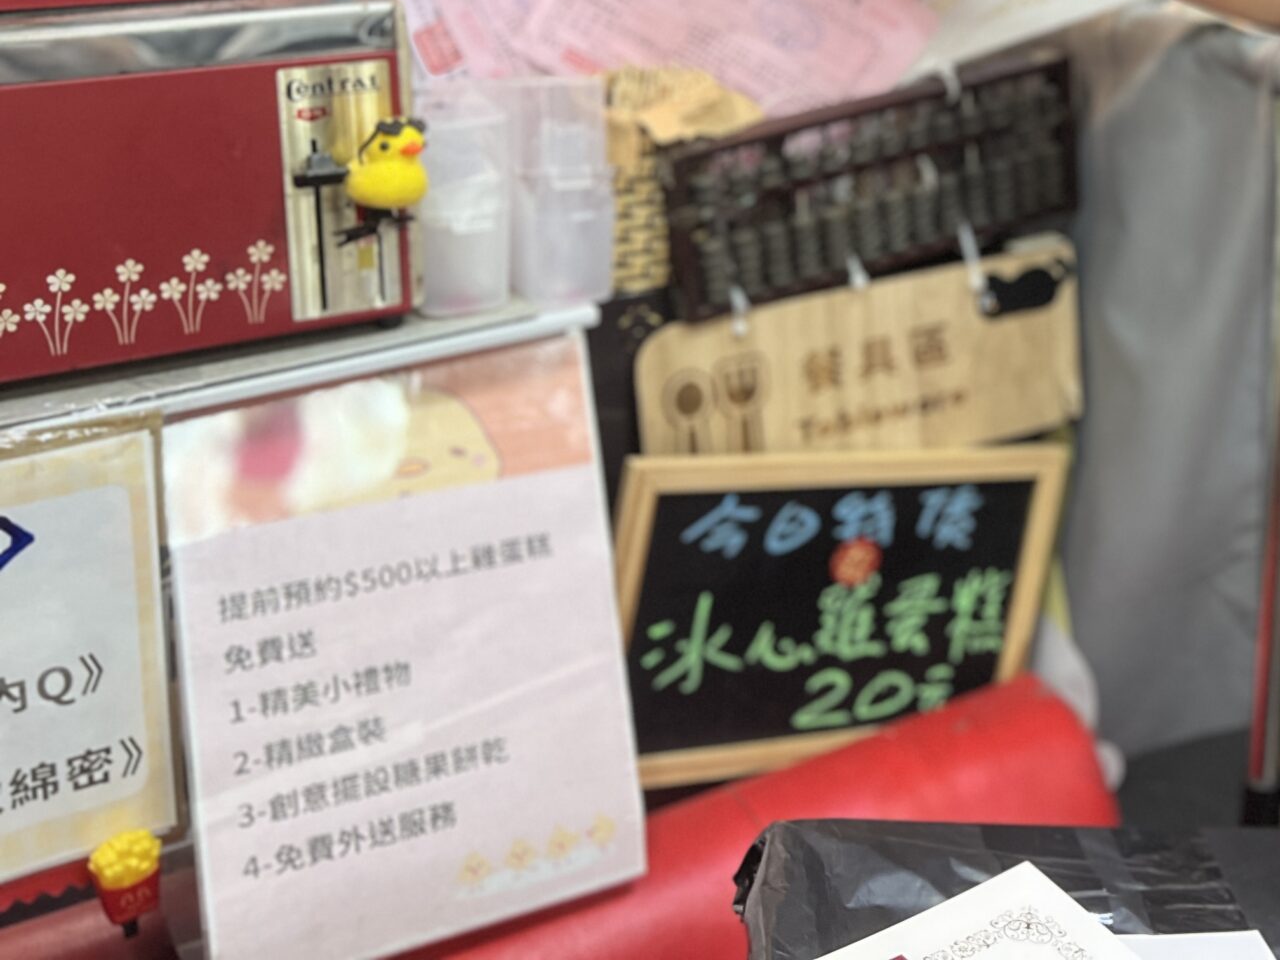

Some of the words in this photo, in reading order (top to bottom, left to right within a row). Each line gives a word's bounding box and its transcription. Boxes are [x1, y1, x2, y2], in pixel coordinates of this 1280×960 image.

[218, 532, 555, 624] 提前預約$500以上雞蛋糕
[224, 630, 318, 675] 免費送
[641, 567, 1010, 695] 冰心雞蛋糕
[229, 662, 411, 724] 1-精美小禮物
[0, 737, 143, 812] 綿密》
[243, 802, 457, 879] 4-免費外送服務
